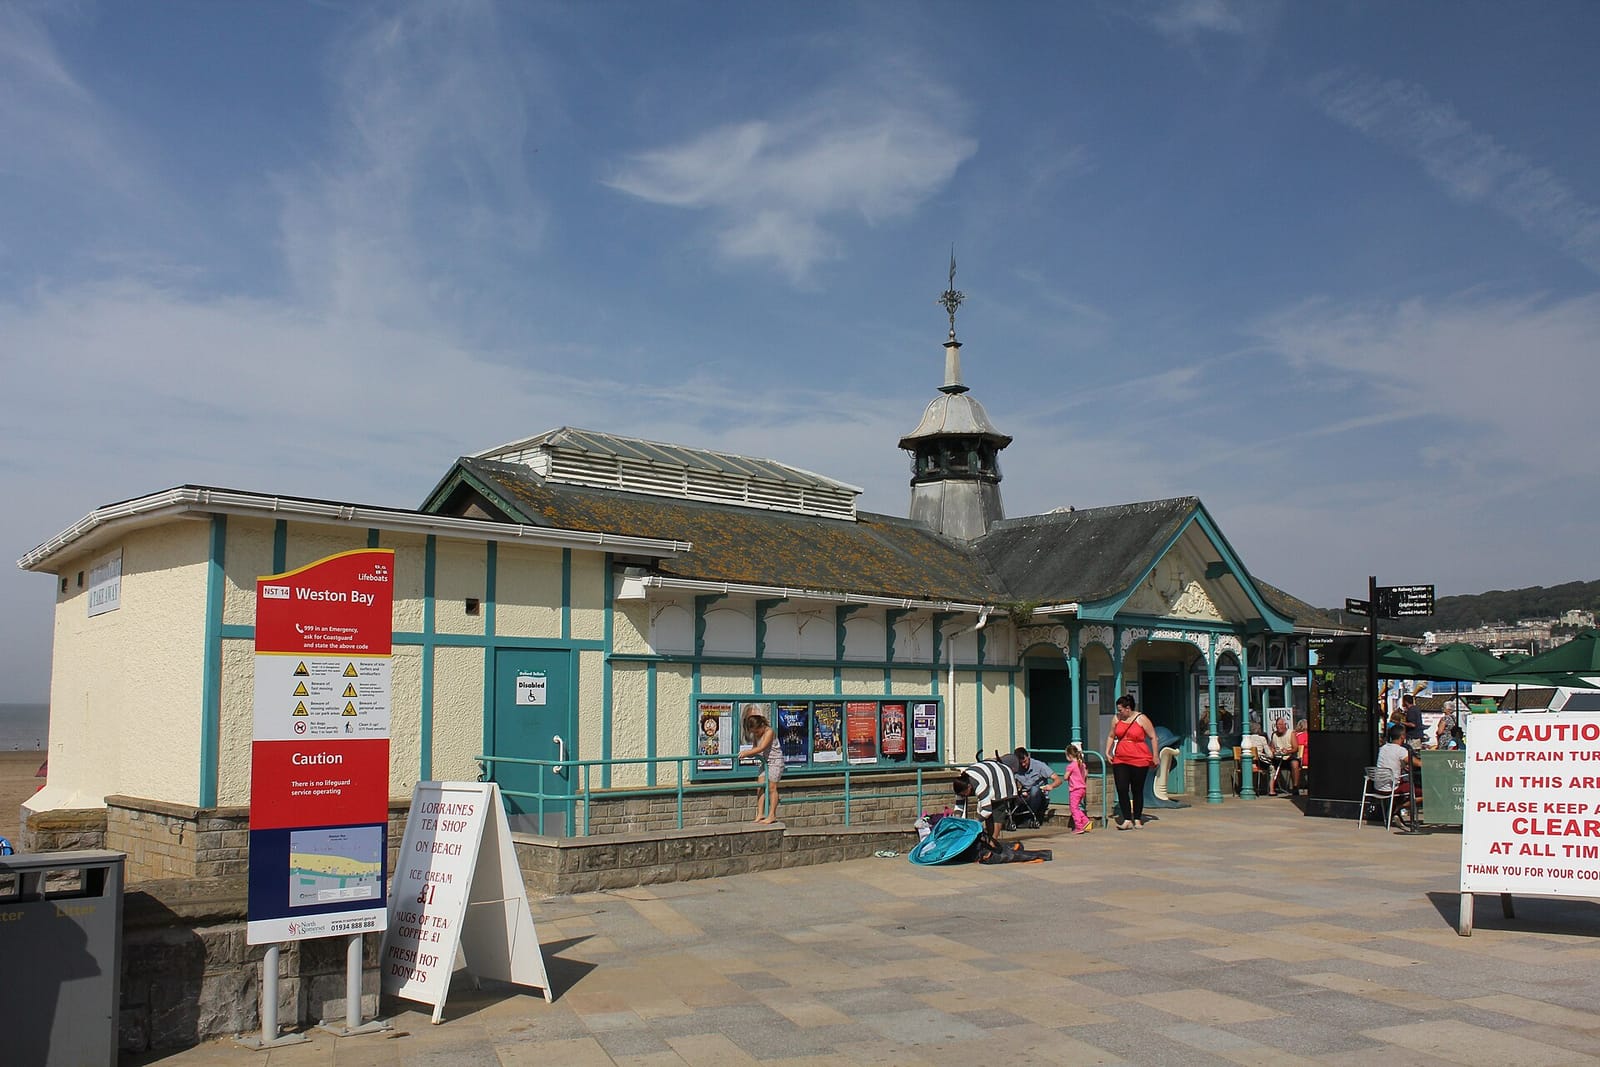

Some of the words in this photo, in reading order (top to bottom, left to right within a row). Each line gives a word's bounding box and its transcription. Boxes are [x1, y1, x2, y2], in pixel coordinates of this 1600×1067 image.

[358, 573, 388, 582] Lifeboats
[295, 588, 347, 602] Weston
[351, 590, 375, 606] Bay
[292, 752, 343, 765] Caution
[1476, 752, 1564, 761] LANDTRAIN
[325, 779, 351, 787] lifeguard
[1496, 777, 1513, 788] IN
[1520, 777, 1562, 788] THIS
[421, 802, 474, 816] LORRAINES
[1477, 802, 1538, 813] PLEASE
[1544, 803, 1588, 814] KEEP
[421, 819, 438, 831] TEA
[441, 820, 467, 832] SHOP
[1512, 817, 1600, 837] CLEAR
[416, 840, 429, 852] ON
[431, 841, 462, 856] BEACH
[1490, 842, 1513, 854] AT
[1519, 843, 1556, 856] ALL
[409, 869, 422, 880] ICE
[425, 871, 453, 884] CREAM
[1467, 865, 1499, 875] THANK
[1502, 866, 1521, 876] YOU
[1525, 867, 1544, 877] FOR
[1547, 868, 1574, 879] YOUR
[1577, 870, 1600, 880] COO
[417, 883, 435, 905] £1
[419, 914, 430, 925] OF
[302, 926, 325, 934] Somerset
[399, 926, 429, 940] COFFEE
[431, 932, 440, 943] £1
[389, 946, 417, 964] FRESH
[419, 954, 439, 967] HOT
[391, 964, 427, 983] DONUTS
